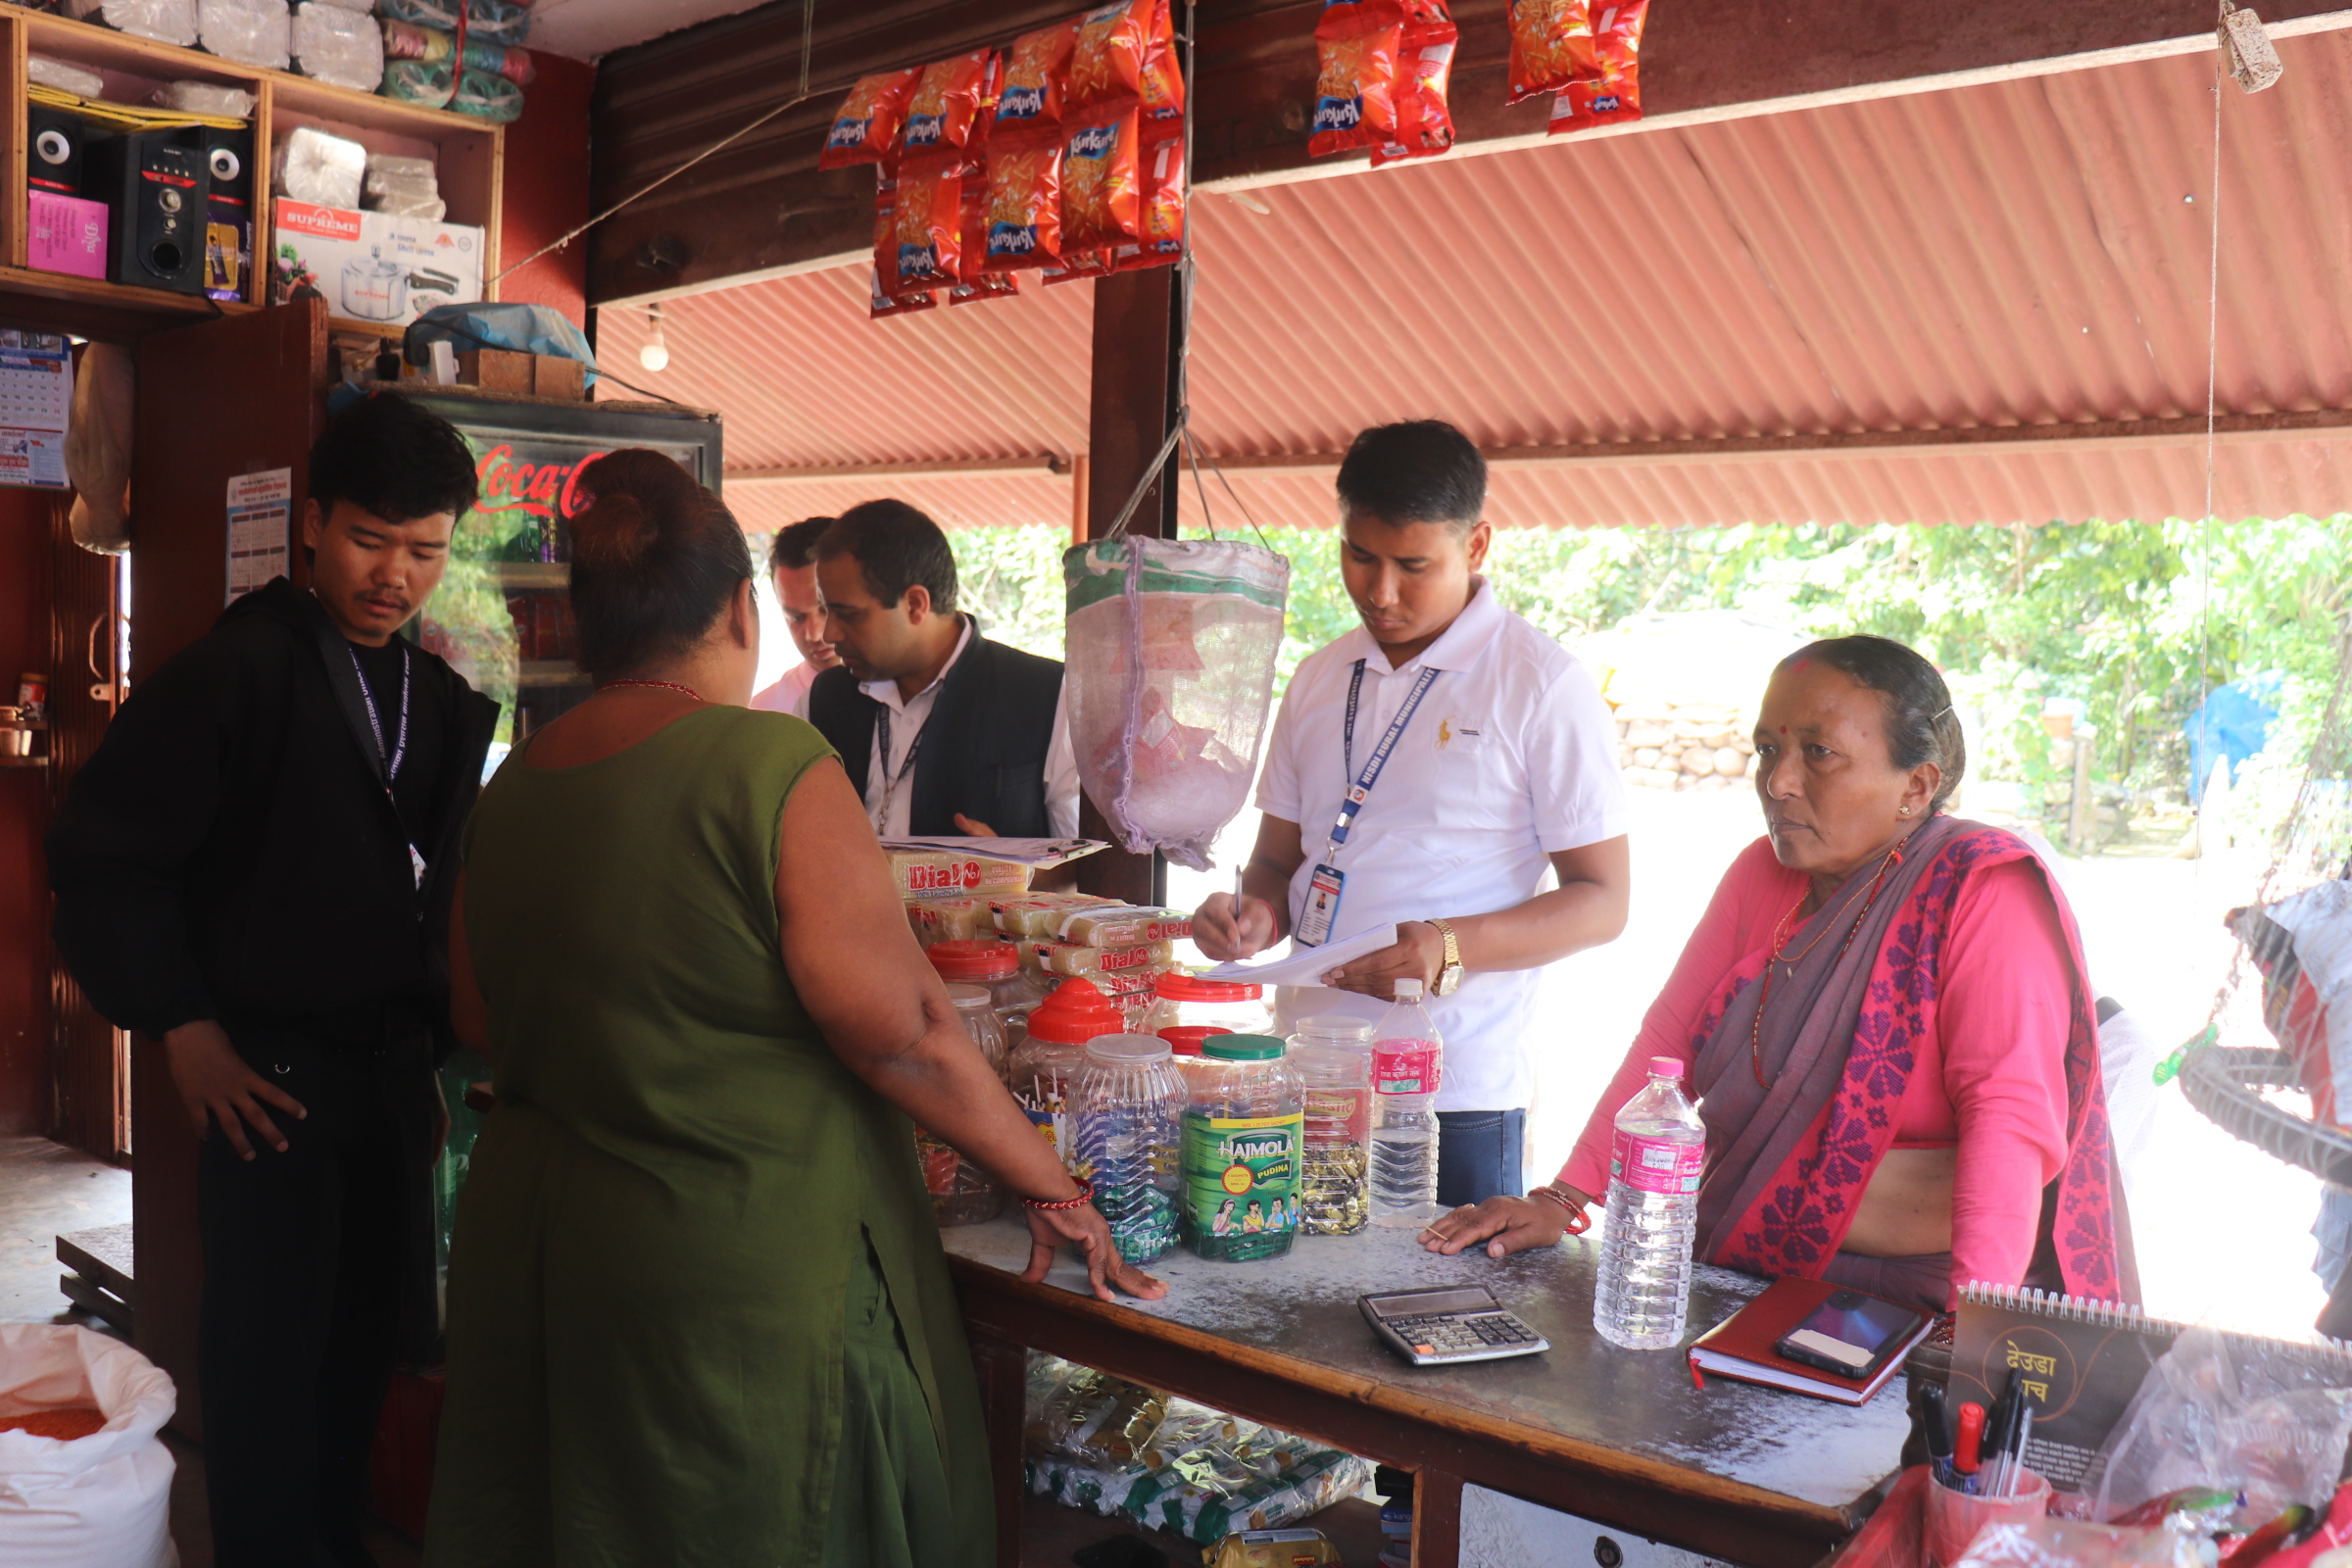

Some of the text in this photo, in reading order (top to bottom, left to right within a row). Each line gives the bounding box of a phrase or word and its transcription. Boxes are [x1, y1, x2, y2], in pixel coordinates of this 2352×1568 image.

[997, 89, 1042, 117] Kurkure
[1069, 128, 1114, 159] Kurkure
[286, 212, 359, 234] SUPREME
[988, 226, 1036, 253] Kurkure
[1361, 668, 1437, 784] NISDI RURAL MUNICIPALIT
[908, 862, 961, 891] Dial
[1100, 949, 1135, 971] Dial
[1216, 1139, 1295, 1161] HAJMOLA
[1256, 1163, 1290, 1180] PUDINA
[2021, 1379, 2048, 1403] ाच
